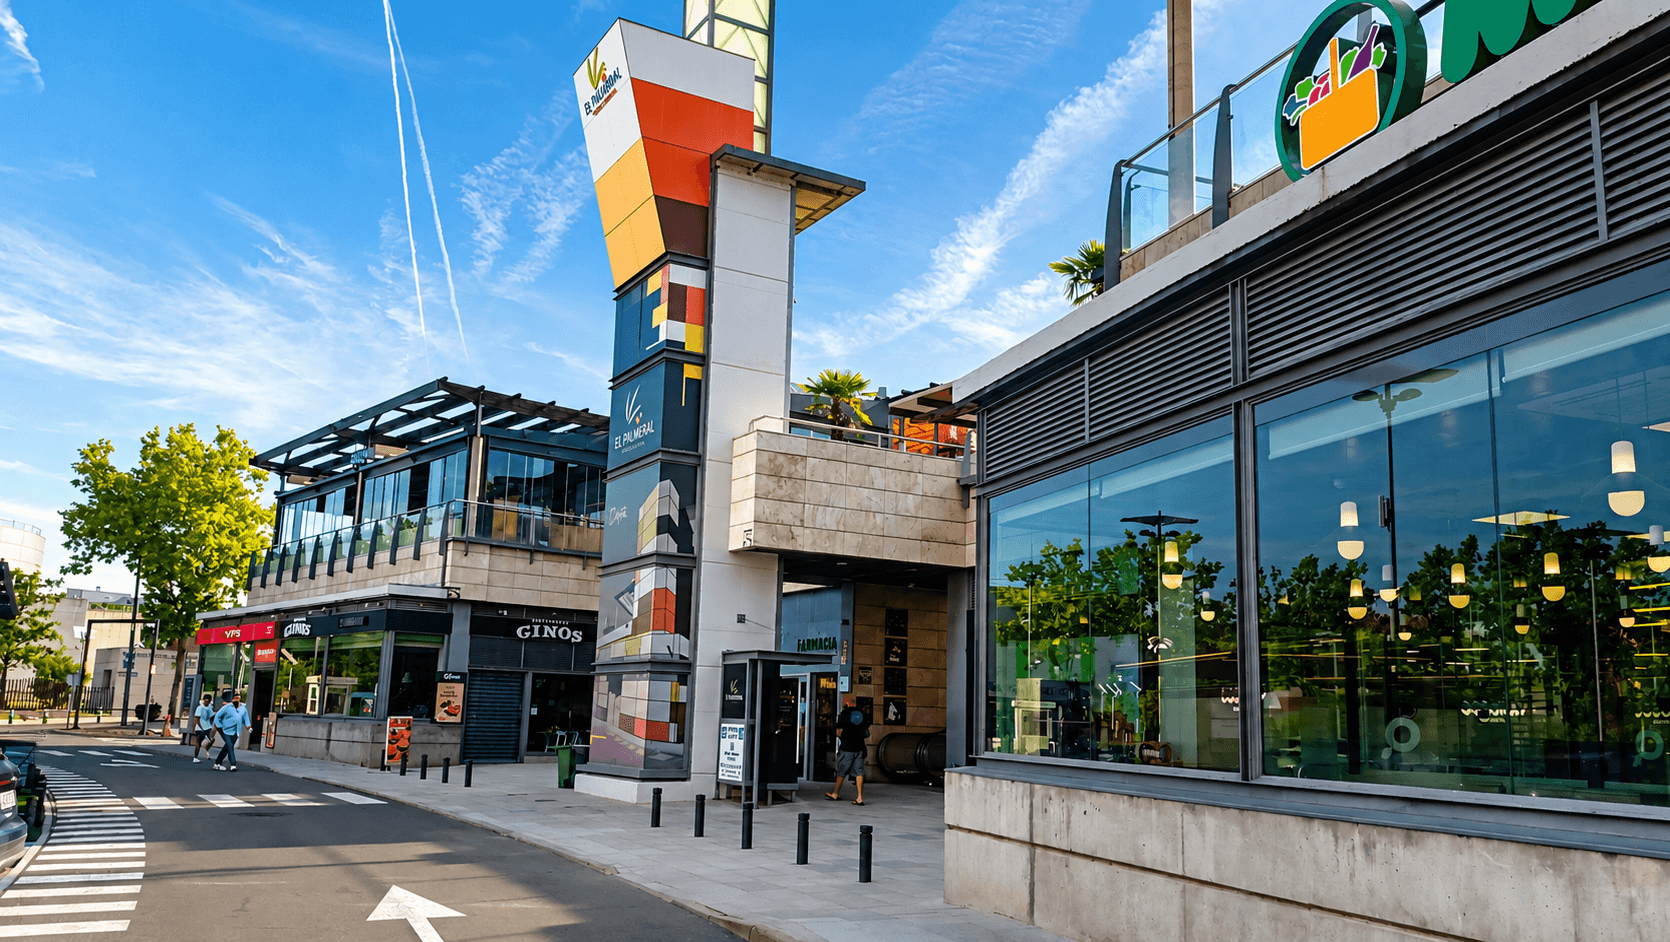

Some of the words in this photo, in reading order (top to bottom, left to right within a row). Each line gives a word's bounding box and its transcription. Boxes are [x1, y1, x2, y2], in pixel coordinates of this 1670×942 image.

[614, 434, 622, 450] EL
[516, 624, 583, 643] GINOS
[797, 637, 837, 652] FARMACIA
